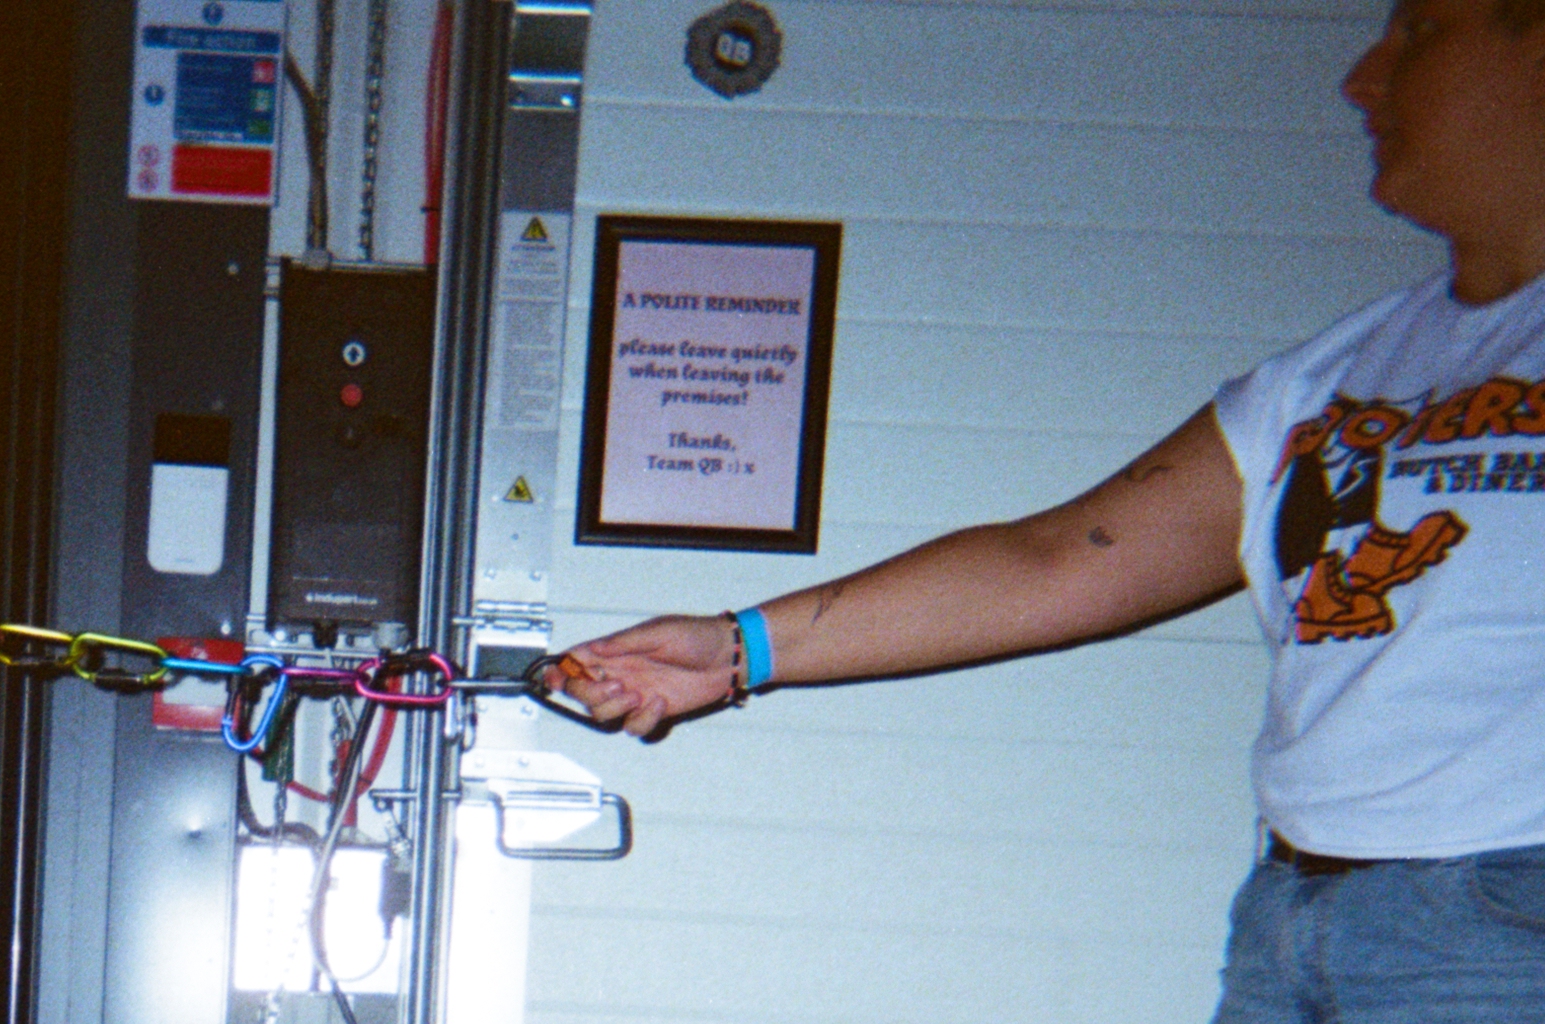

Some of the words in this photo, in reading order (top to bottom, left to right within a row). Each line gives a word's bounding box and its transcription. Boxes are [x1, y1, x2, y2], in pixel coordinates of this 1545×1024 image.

[622, 292, 637, 308] A
[640, 294, 700, 311] POLITE
[705, 296, 801, 316] REMINDER
[619, 338, 675, 358] please
[679, 340, 727, 359] leave
[730, 343, 798, 367] quietly
[629, 362, 678, 380] when
[682, 363, 750, 388] leaving
[754, 366, 785, 385] the
[661, 389, 749, 408] premises!
[668, 432, 737, 453] Thanks,
[647, 454, 694, 471] Team
[698, 457, 723, 476] QB
